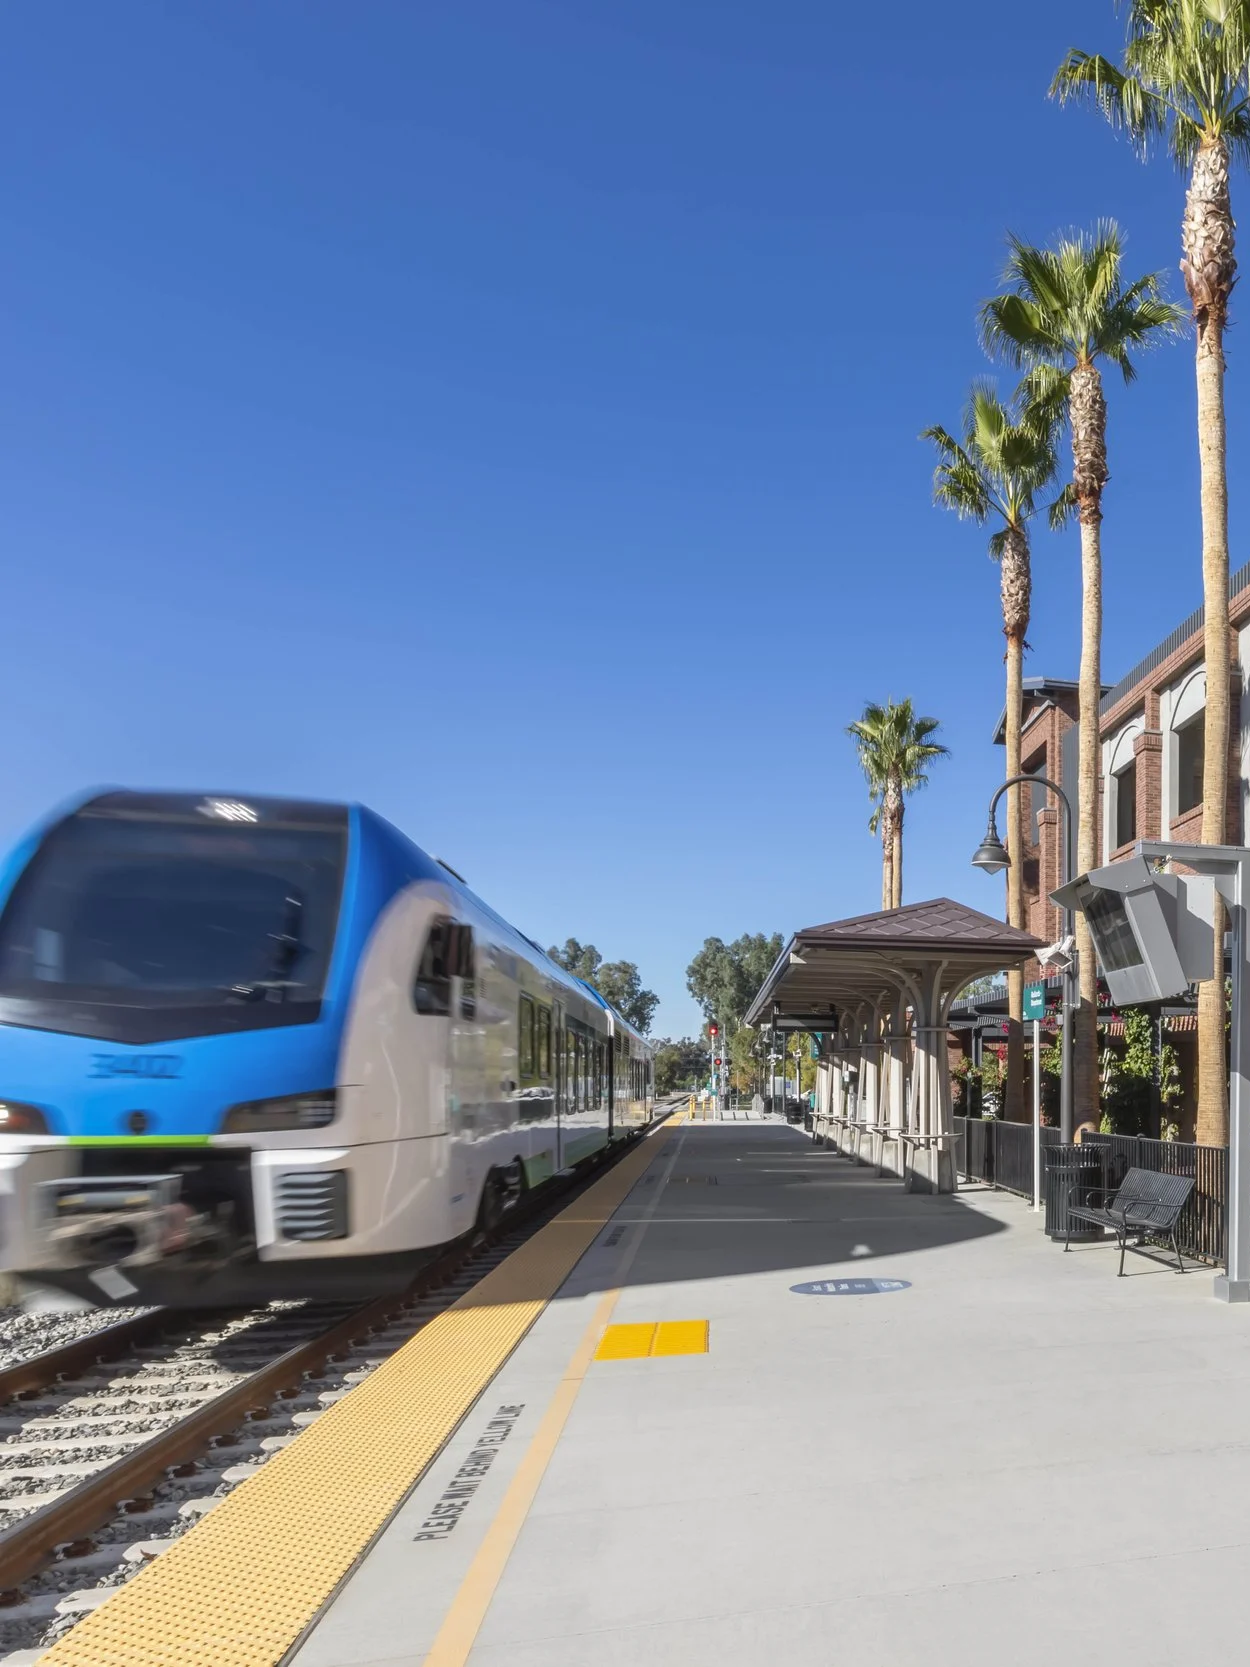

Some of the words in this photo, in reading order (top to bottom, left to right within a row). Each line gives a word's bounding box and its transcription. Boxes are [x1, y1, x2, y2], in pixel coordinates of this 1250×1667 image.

[492, 1404, 526, 1420] LINE
[474, 1419, 517, 1448] YELLOW
[455, 1448, 499, 1478] BEHIND
[441, 1479, 482, 1501] WAIT
[412, 1500, 470, 1541] PLEASE
